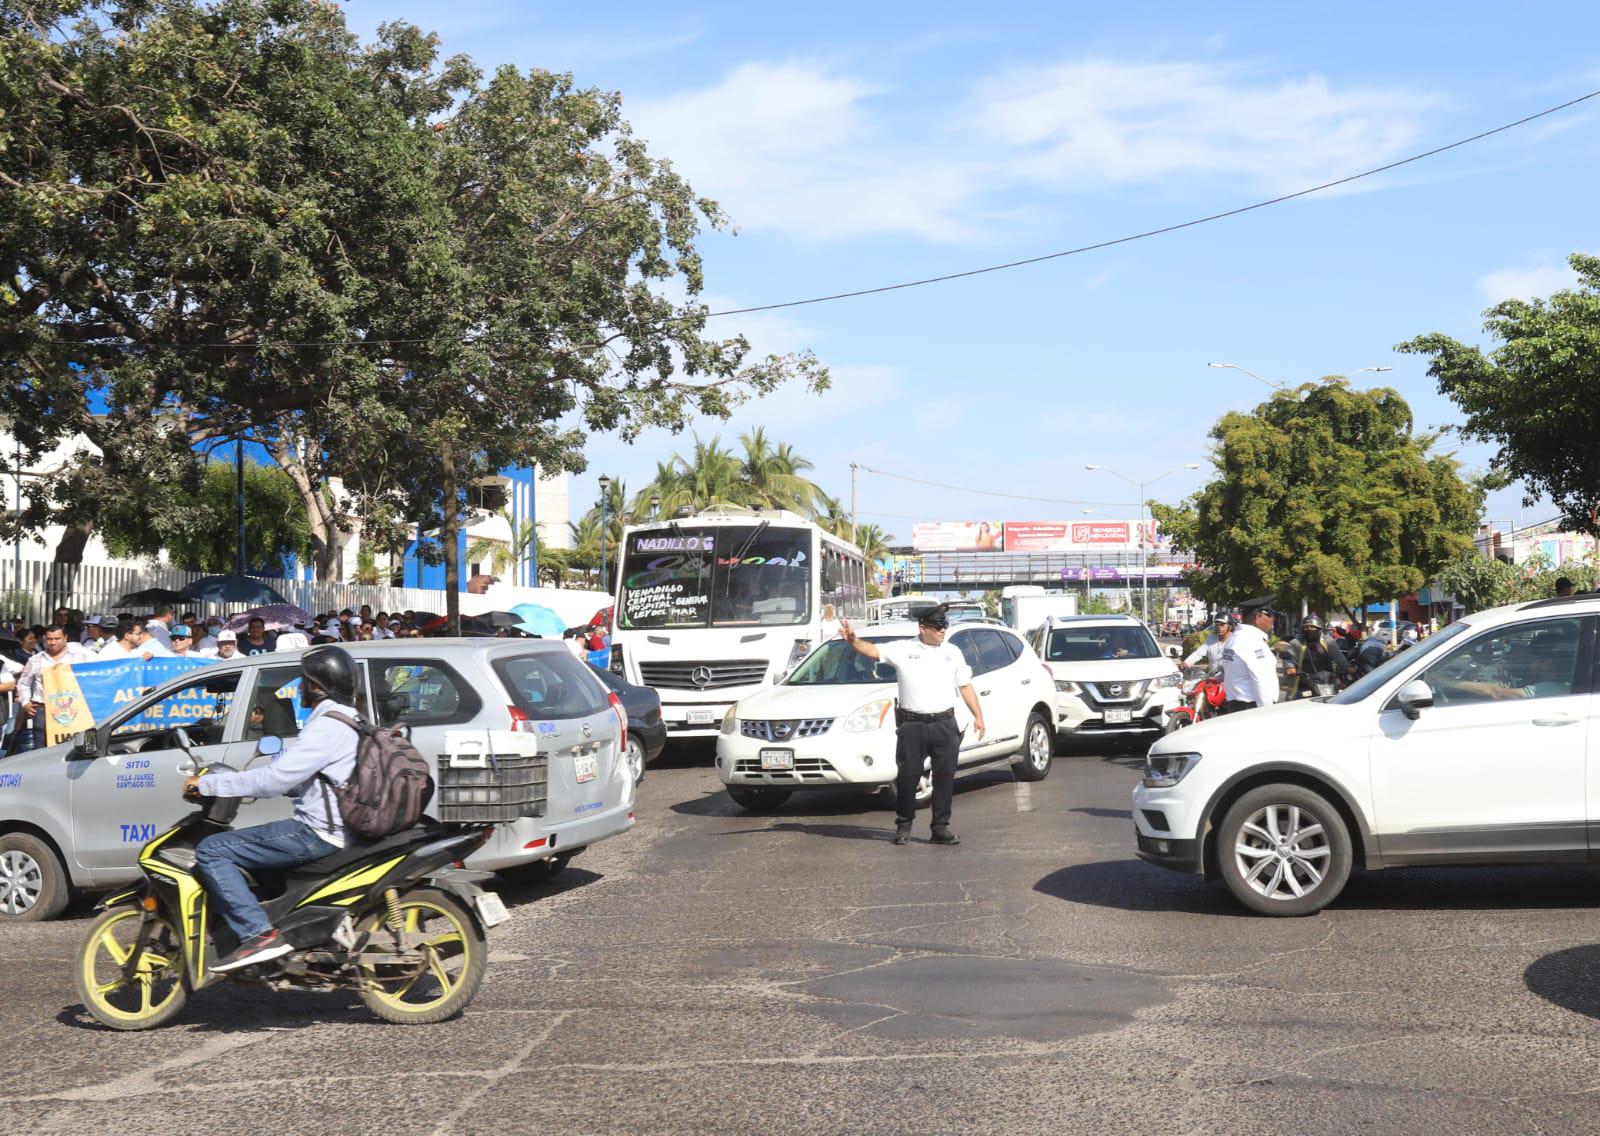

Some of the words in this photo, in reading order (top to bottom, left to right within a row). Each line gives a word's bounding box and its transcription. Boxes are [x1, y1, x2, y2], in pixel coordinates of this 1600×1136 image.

[628, 585, 683, 599] VENADILLO
[627, 593, 673, 606] CENTRAL
[634, 609, 651, 619] LEY
[671, 607, 697, 616] MAR
[125, 760, 150, 769] SITIO
[116, 781, 144, 789] SANTIAGO
[120, 824, 156, 842] TAXI
